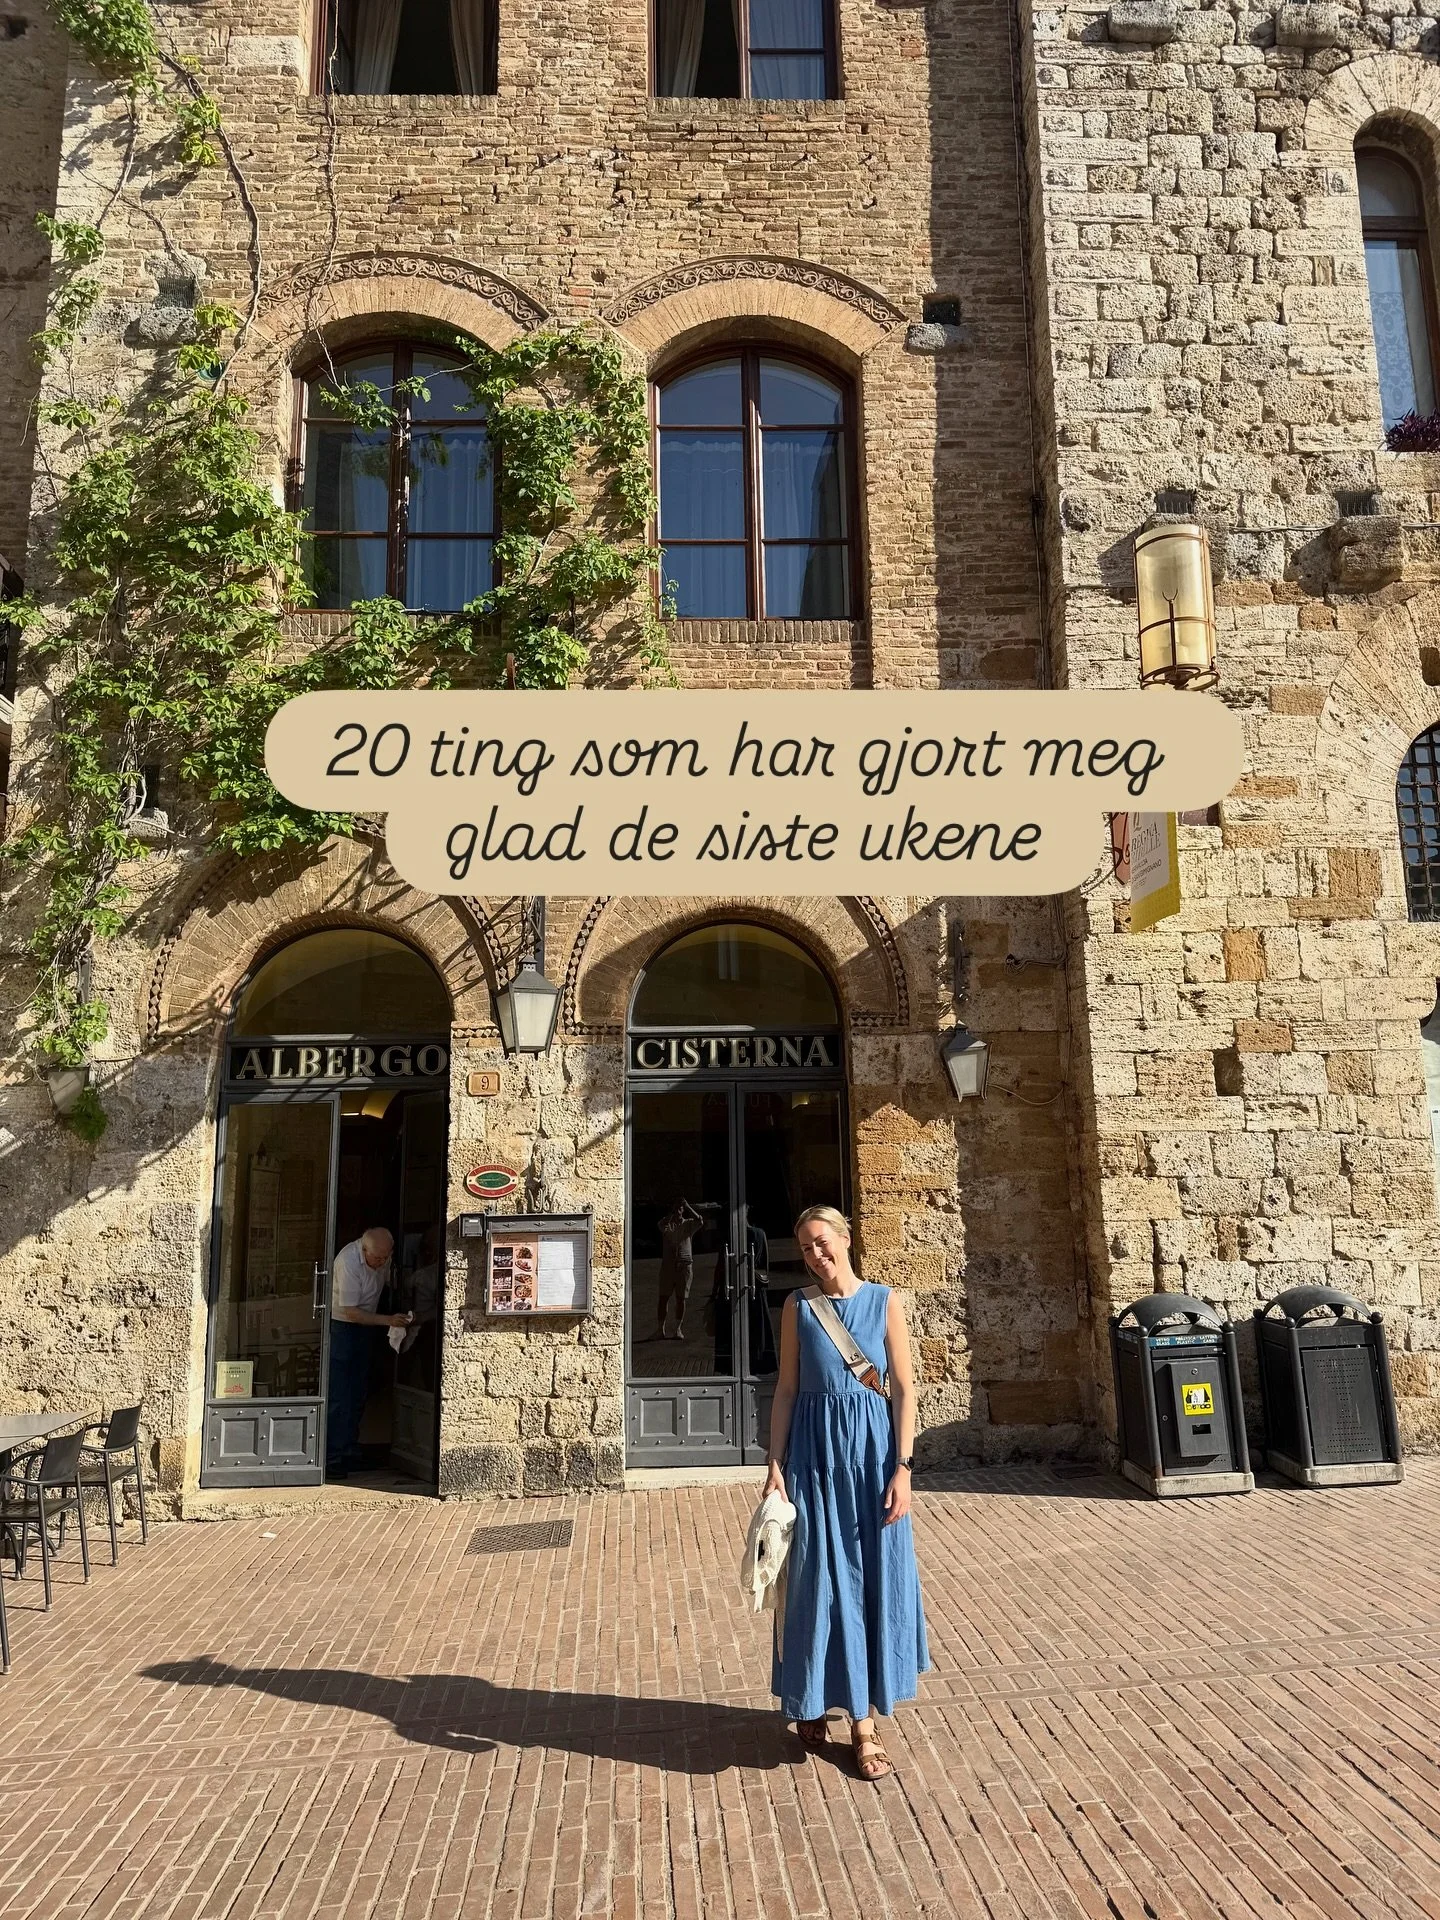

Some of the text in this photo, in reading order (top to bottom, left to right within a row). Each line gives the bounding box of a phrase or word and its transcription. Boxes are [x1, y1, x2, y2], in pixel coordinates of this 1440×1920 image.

[236, 1036, 834, 1080] ALBERGO CISTERNA
[481, 1075, 490, 1091] 9
